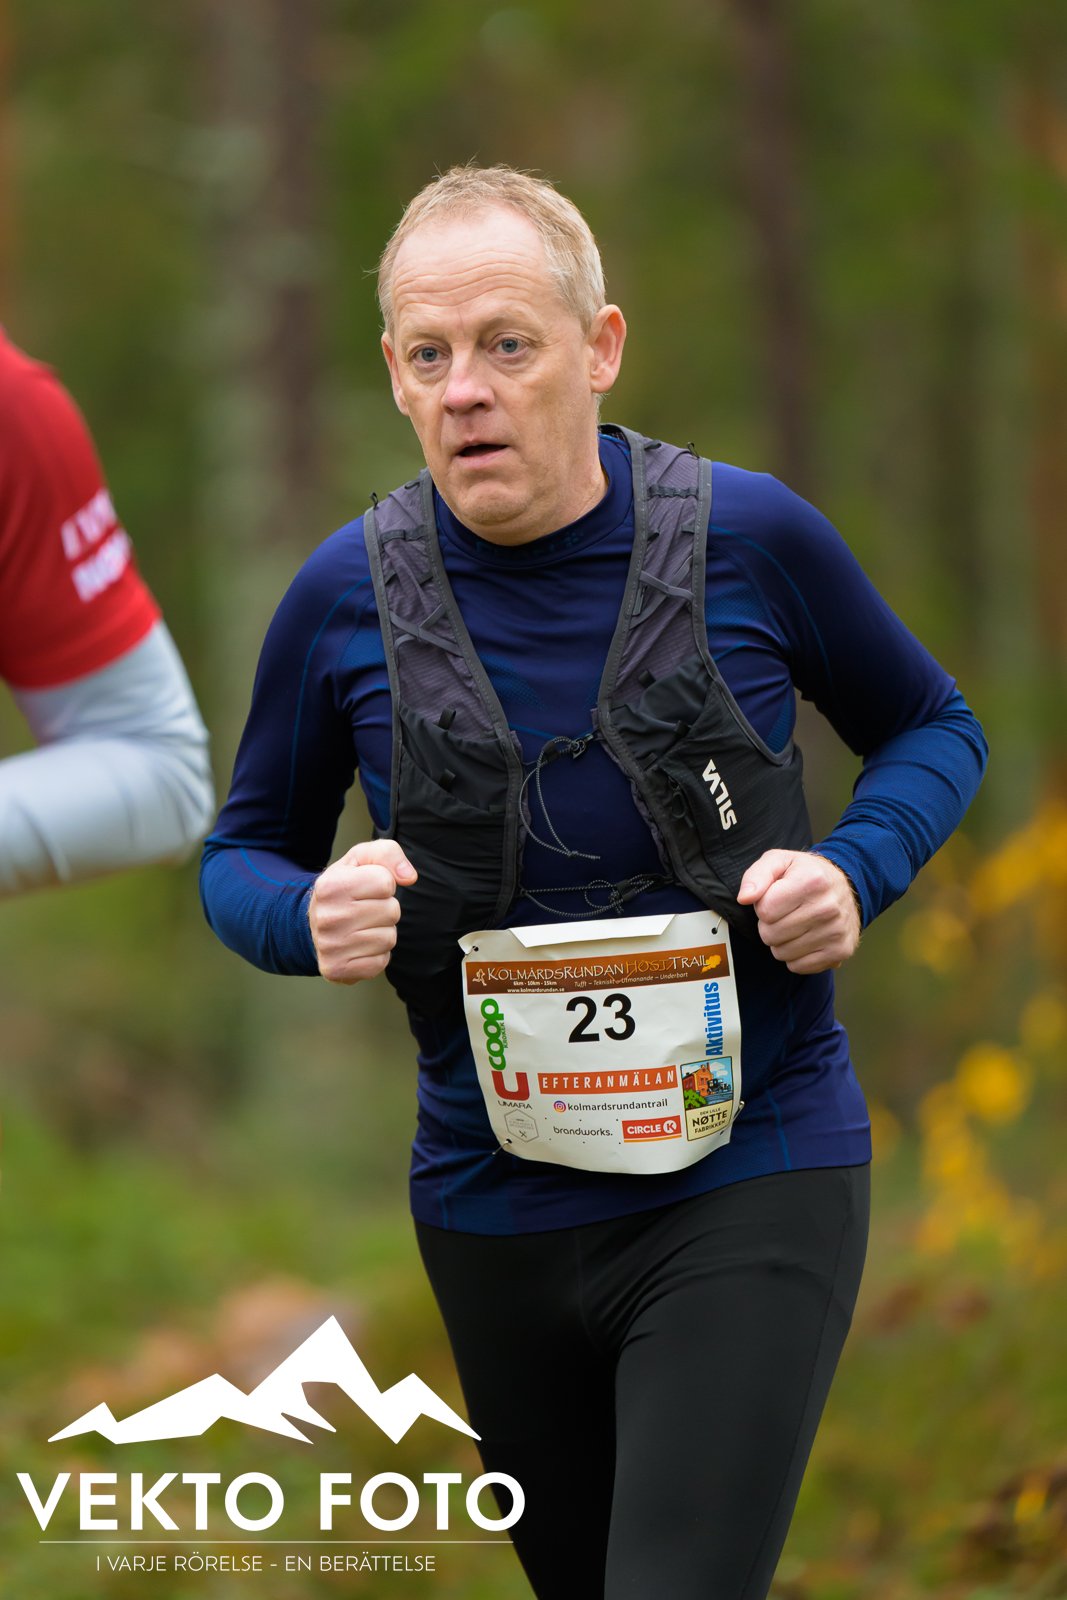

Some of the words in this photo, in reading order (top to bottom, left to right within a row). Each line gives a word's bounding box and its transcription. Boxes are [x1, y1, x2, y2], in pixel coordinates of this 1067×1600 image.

[702, 758, 737, 830] SILVA
[566, 993, 636, 1043] 23
[704, 982, 723, 1055] Aktivitus
[480, 998, 506, 1070] coop
[542, 1070, 674, 1089] EFTERANMÄLAN
[497, 1100, 533, 1110] UMARA
[567, 1098, 668, 1111] kolmardsrundantrail
[626, 1123, 661, 1135] CIRCLE
[664, 1120, 677, 1133] K
[692, 1110, 728, 1127] NØTTE
[553, 1125, 613, 1137] brandworks.
